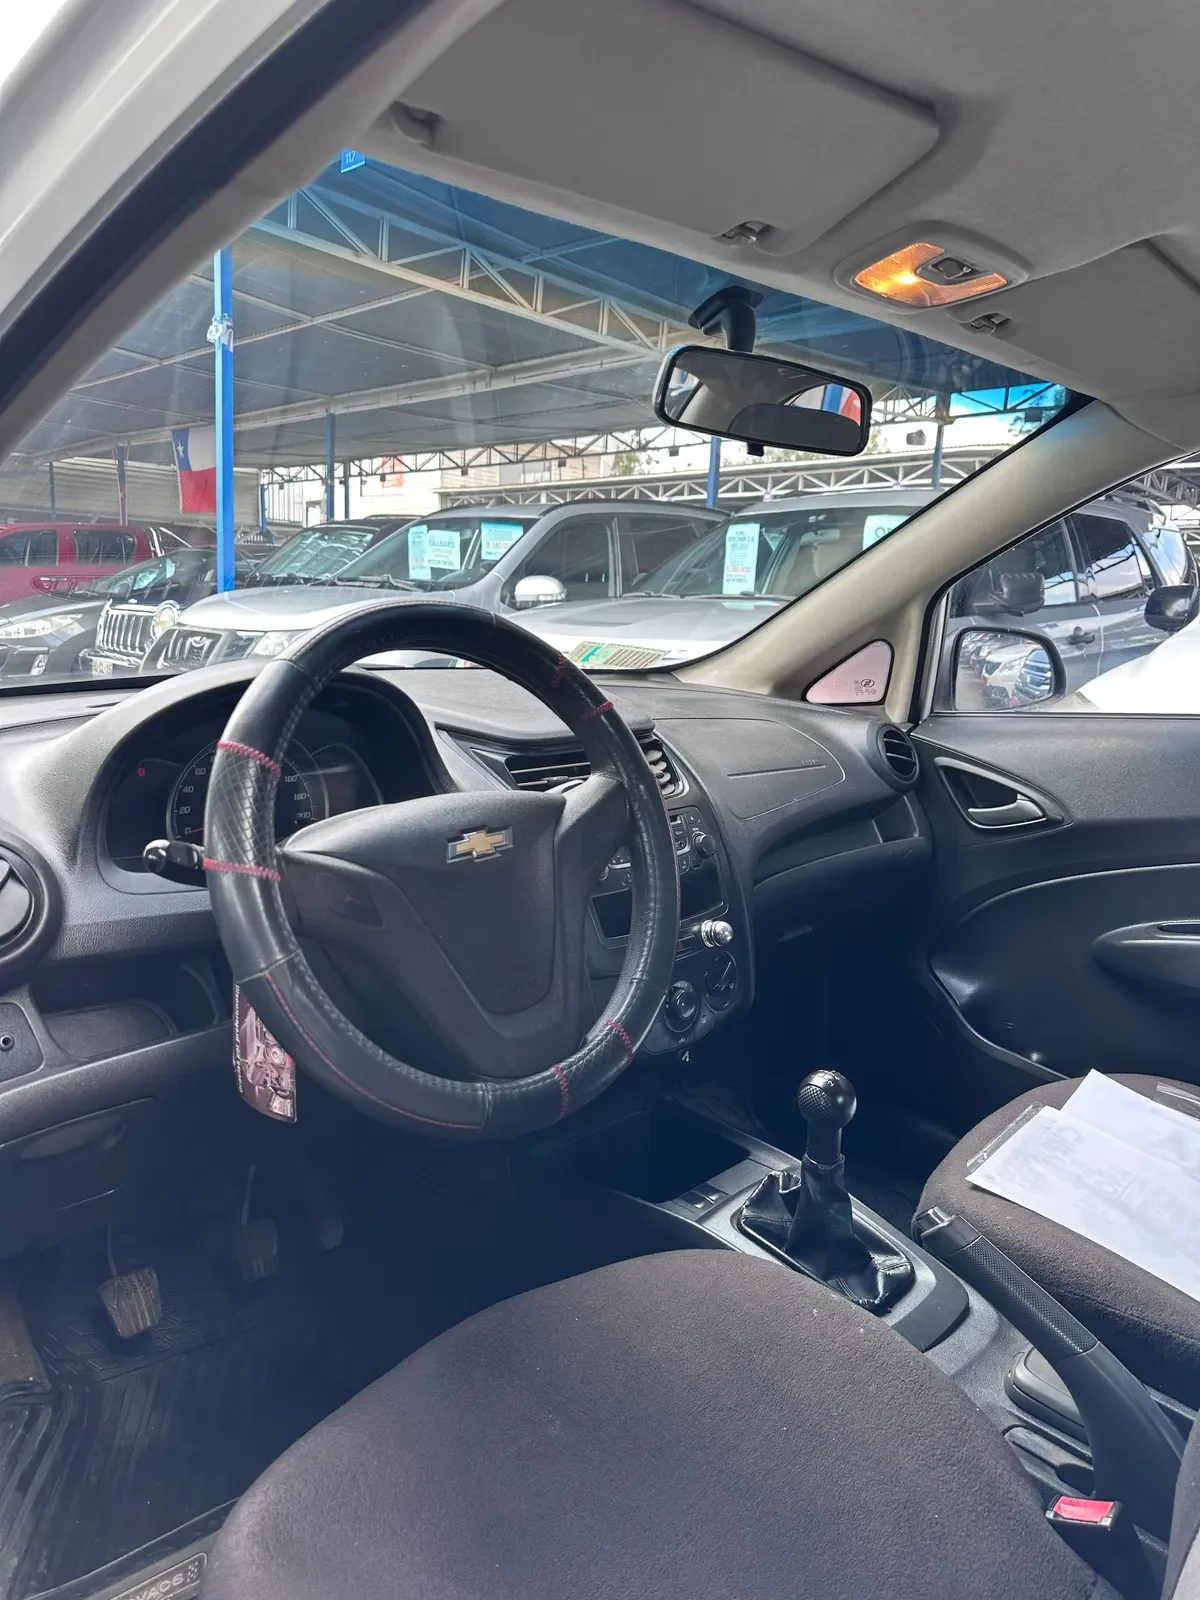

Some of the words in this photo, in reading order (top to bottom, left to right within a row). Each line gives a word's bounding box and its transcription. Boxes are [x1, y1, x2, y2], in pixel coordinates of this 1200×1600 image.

[345, 150, 356, 164] 117
[194, 767, 206, 776] 60
[284, 775, 298, 783] 160
[183, 785, 194, 793] 40
[294, 792, 307, 800] 180
[179, 805, 191, 814] 20
